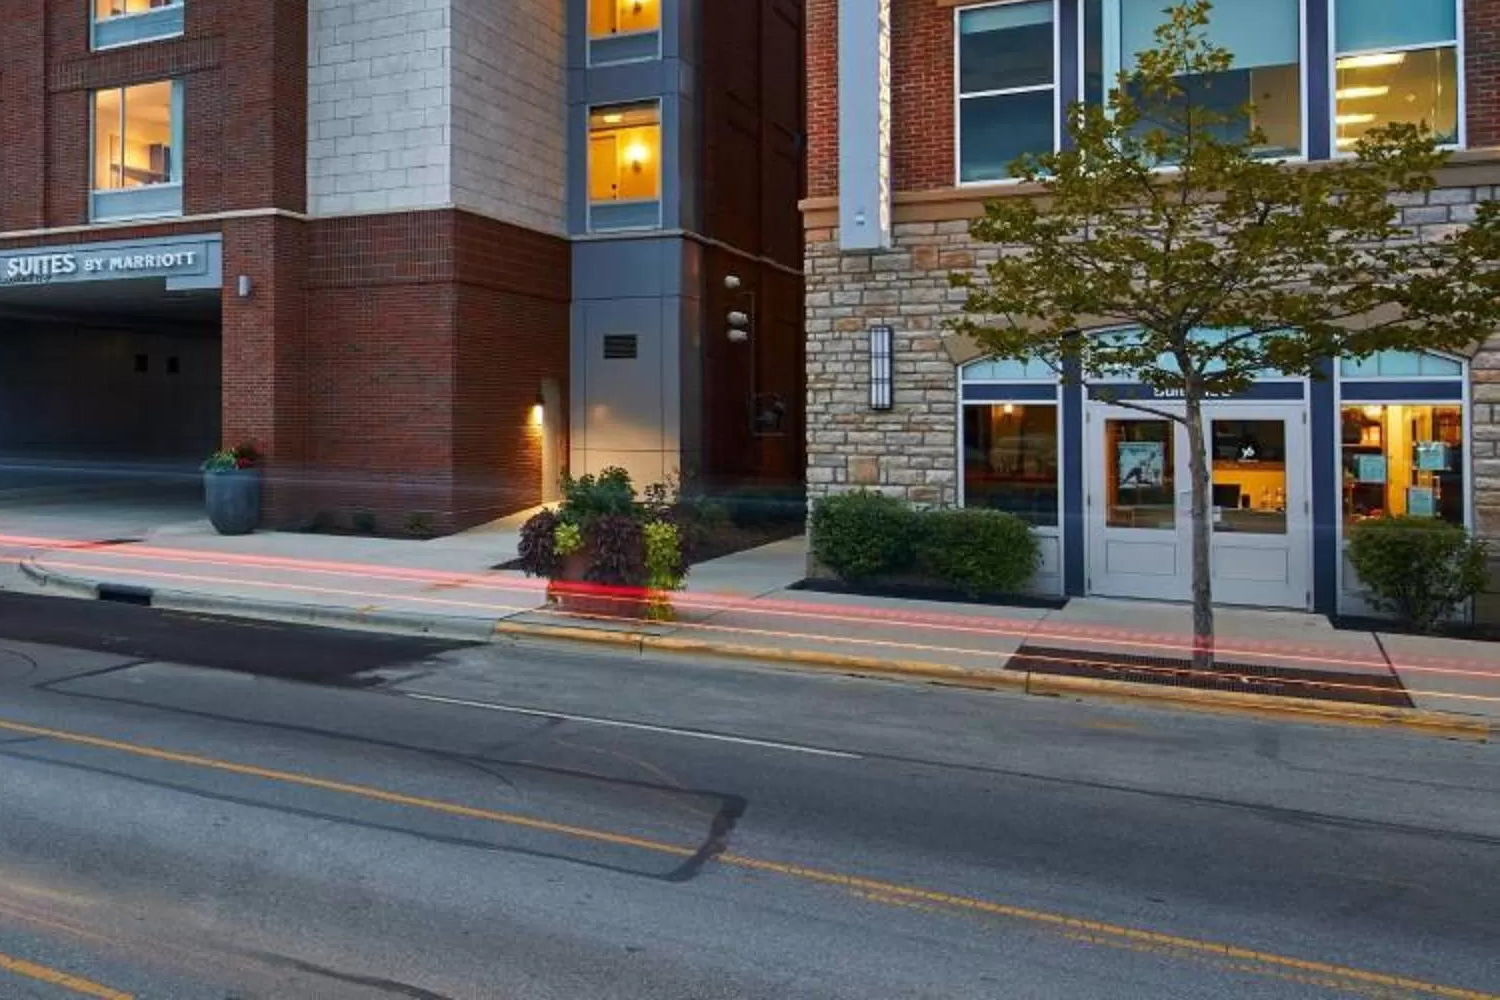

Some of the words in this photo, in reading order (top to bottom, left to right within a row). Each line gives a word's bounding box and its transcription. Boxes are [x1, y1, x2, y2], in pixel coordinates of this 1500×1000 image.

[7, 253, 77, 277] SUITES
[83, 258, 103, 271] BY
[109, 251, 197, 271] MARRIOTT
